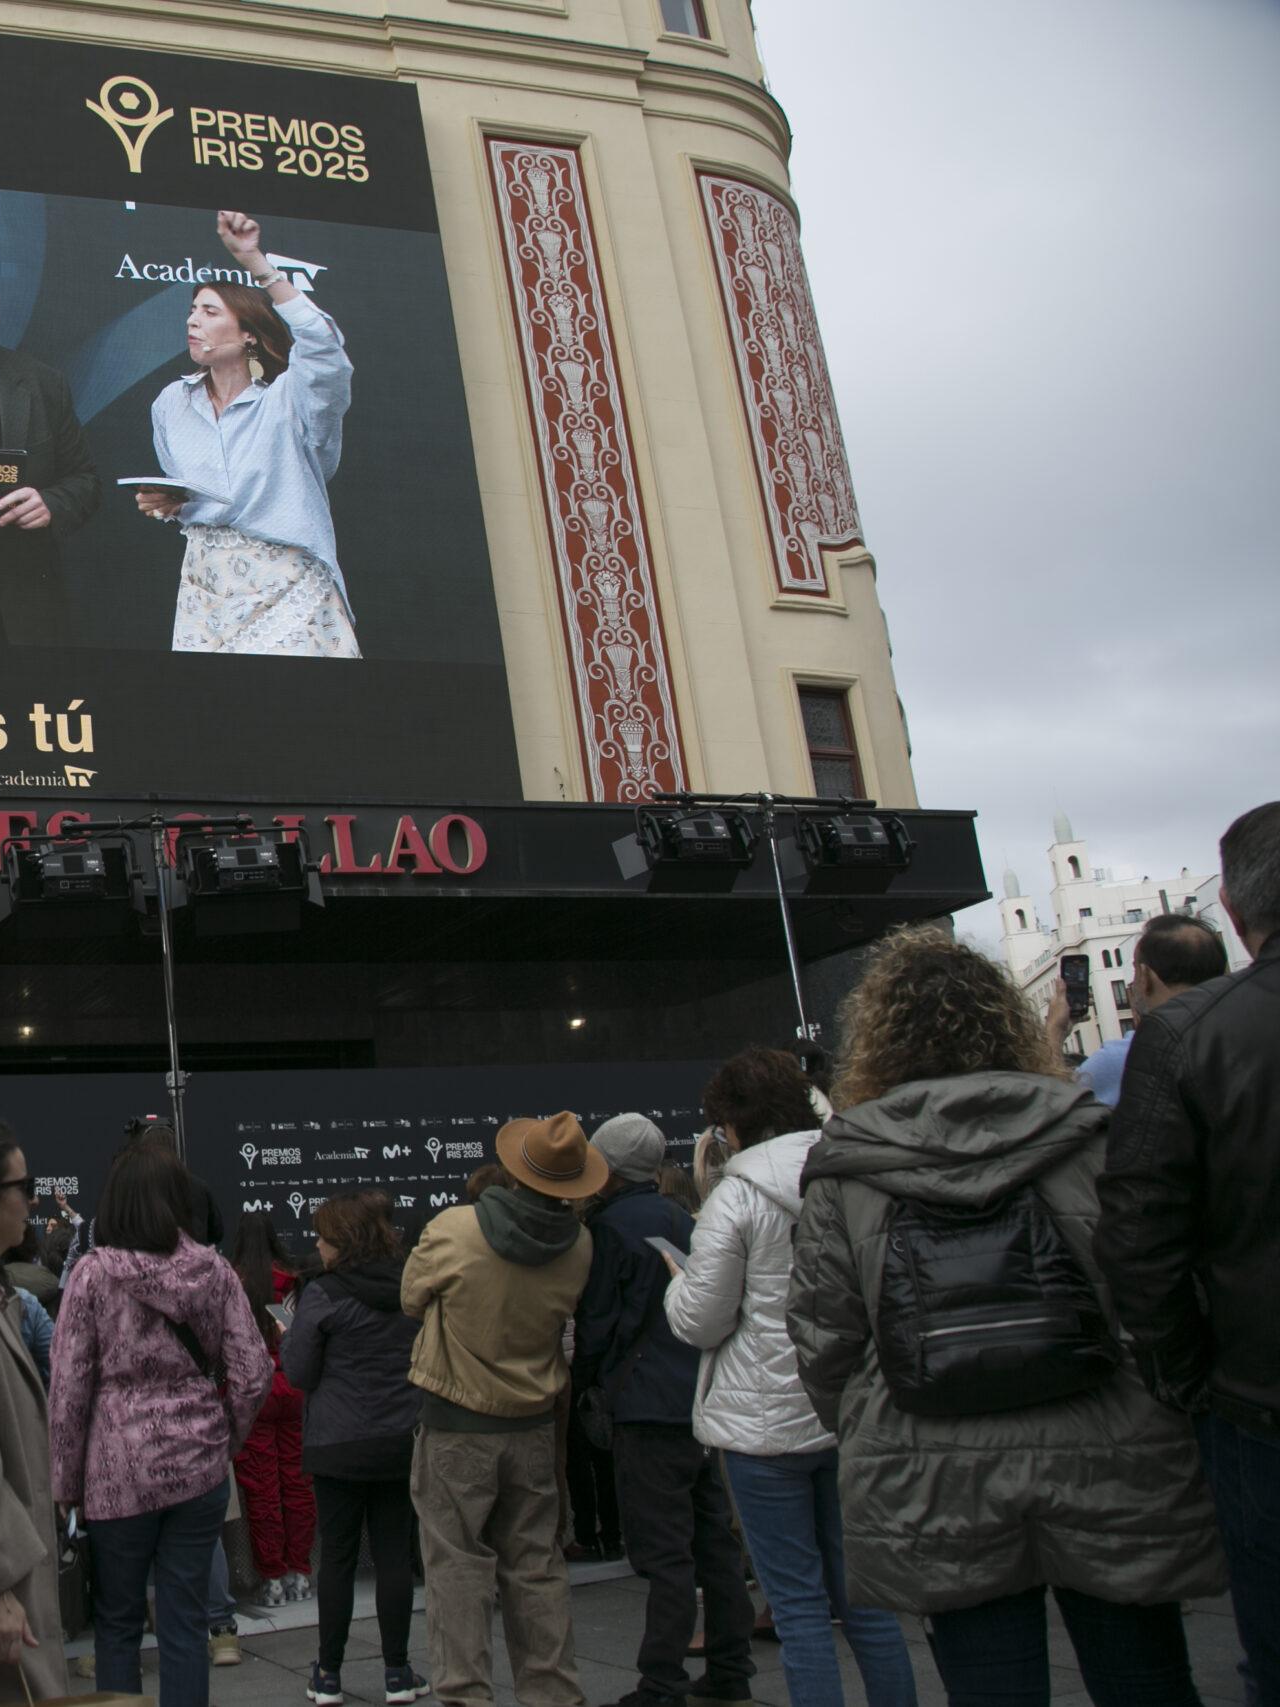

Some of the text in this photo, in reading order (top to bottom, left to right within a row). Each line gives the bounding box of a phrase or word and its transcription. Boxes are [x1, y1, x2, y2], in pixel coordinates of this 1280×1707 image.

[190, 107, 366, 153] PREMIOS
[193, 137, 370, 183] IRIS 2025
[28, 699, 95, 753] tú
[445, 1142, 483, 1151] PREMIOS
[261, 1148, 302, 1157] PREMIOS
[446, 1149, 484, 1159] IRIS 2025
[262, 1155, 302, 1165] IRIS 2025
[34, 1177, 79, 1186] PREMIOS
